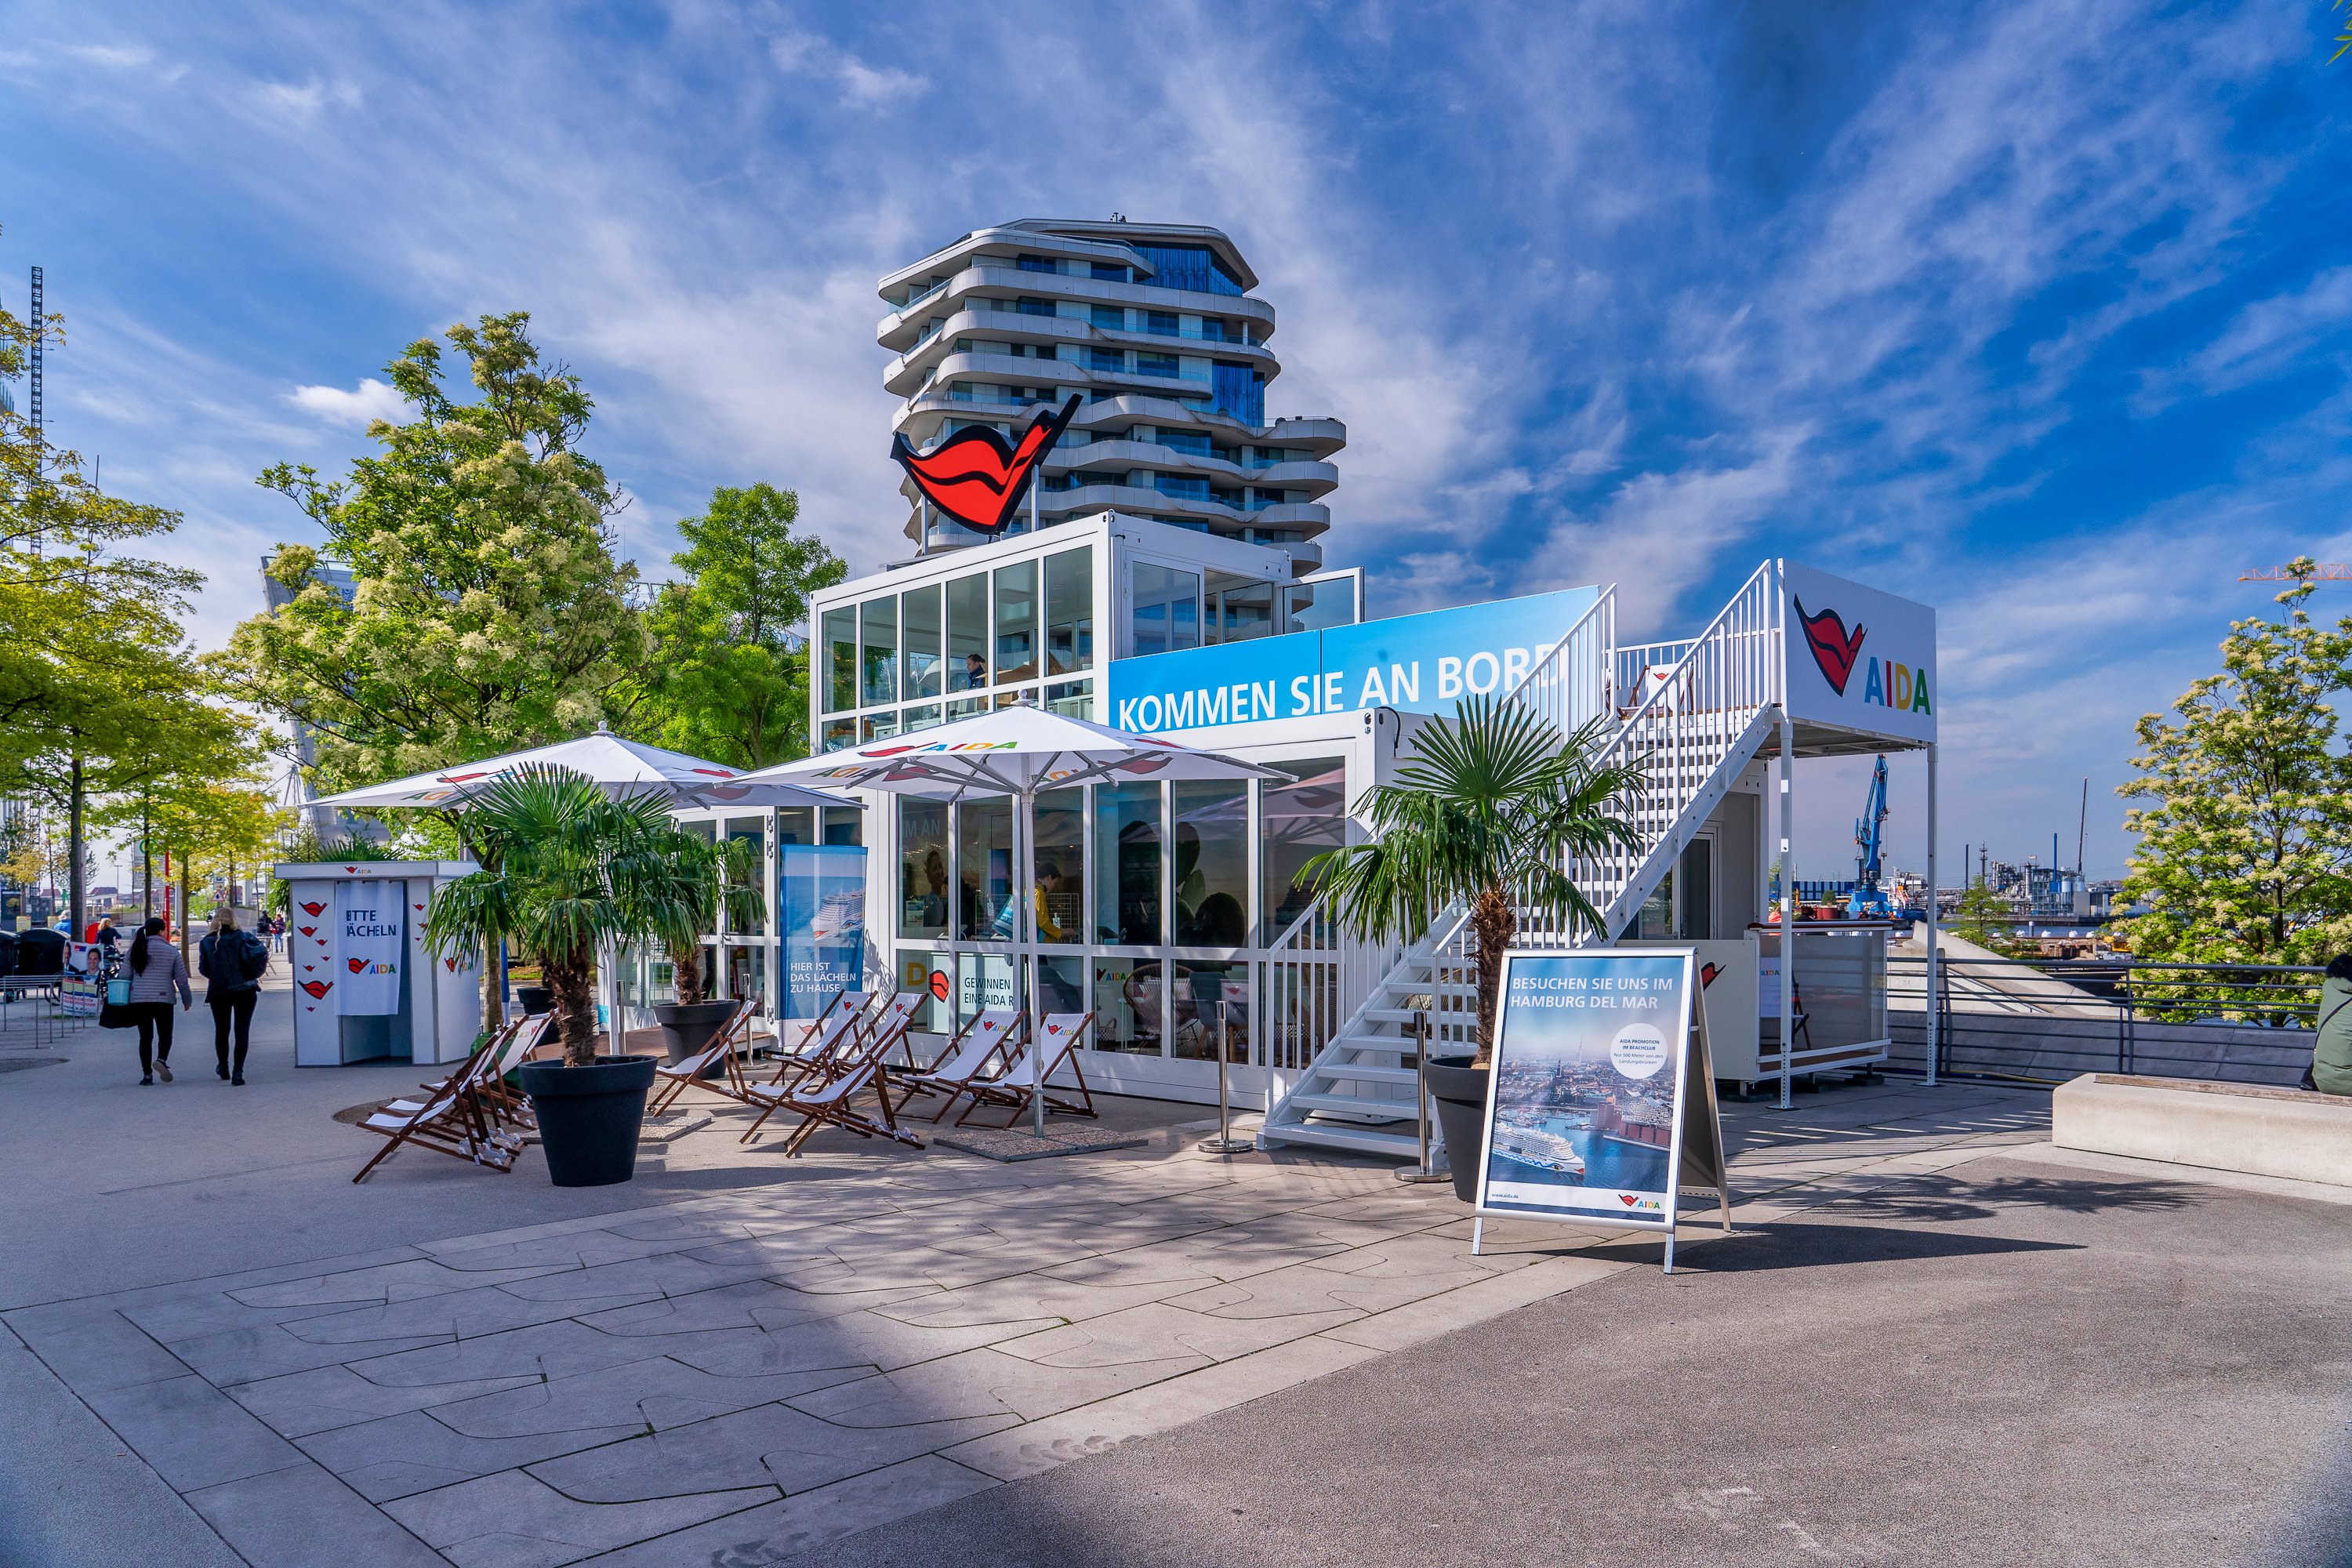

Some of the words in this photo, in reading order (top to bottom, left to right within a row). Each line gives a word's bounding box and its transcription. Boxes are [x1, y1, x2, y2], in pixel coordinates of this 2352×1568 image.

[1120, 680, 1276, 733] KOMMEN
[1290, 671, 1344, 716] SIE
[1358, 661, 1419, 709] AN
[1438, 644, 1568, 699] BORD
[1864, 656, 1931, 716] AIDA
[920, 741, 1018, 753] AIDA
[369, 964, 397, 975] AIDA
[790, 962, 812, 971] HIER
[815, 962, 830, 971] IST
[790, 973, 811, 982] DAS
[814, 971, 856, 982] LÄCHELN
[1105, 972, 1126, 982] AIDA
[790, 984, 804, 993] ZU
[807, 984, 840, 993] HAUSE
[964, 977, 1011, 990] GEWINNEN
[1512, 977, 1587, 990] BESUCHEN
[1592, 978, 1613, 990] SIE
[1617, 978, 1648, 991] UNS
[1653, 978, 1673, 991] IM
[964, 993, 985, 1004] EINE
[985, 995, 1006, 1006] AIDA
[1510, 995, 1585, 1008] HAMBURG
[1589, 996, 1617, 1009] DEL
[1622, 996, 1658, 1009] MAR
[1638, 1200, 1661, 1210] AIDA
